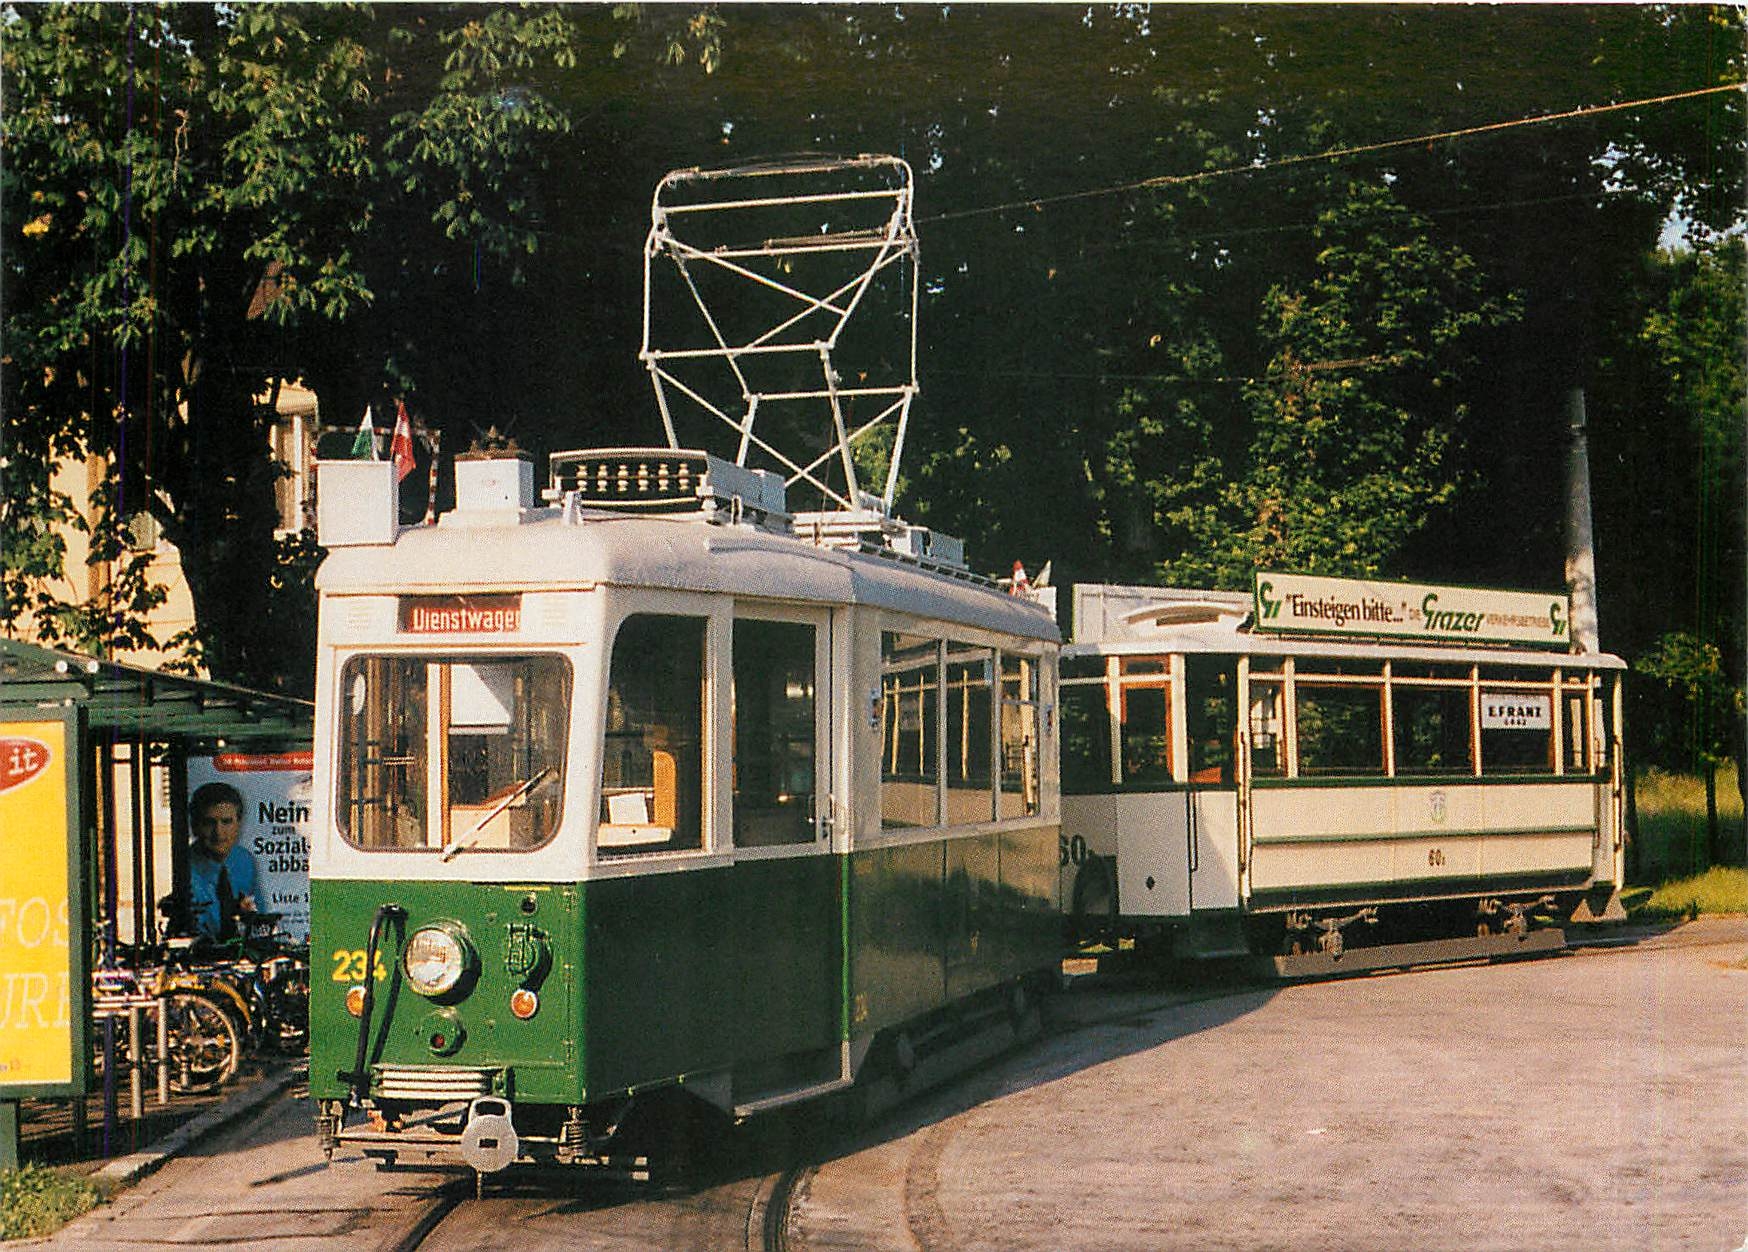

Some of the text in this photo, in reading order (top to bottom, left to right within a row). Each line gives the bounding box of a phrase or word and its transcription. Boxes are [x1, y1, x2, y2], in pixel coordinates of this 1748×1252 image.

[1422, 593, 1485, 632] Grazer
[258, 801, 309, 824] Nein
[332, 949, 387, 982] 234
